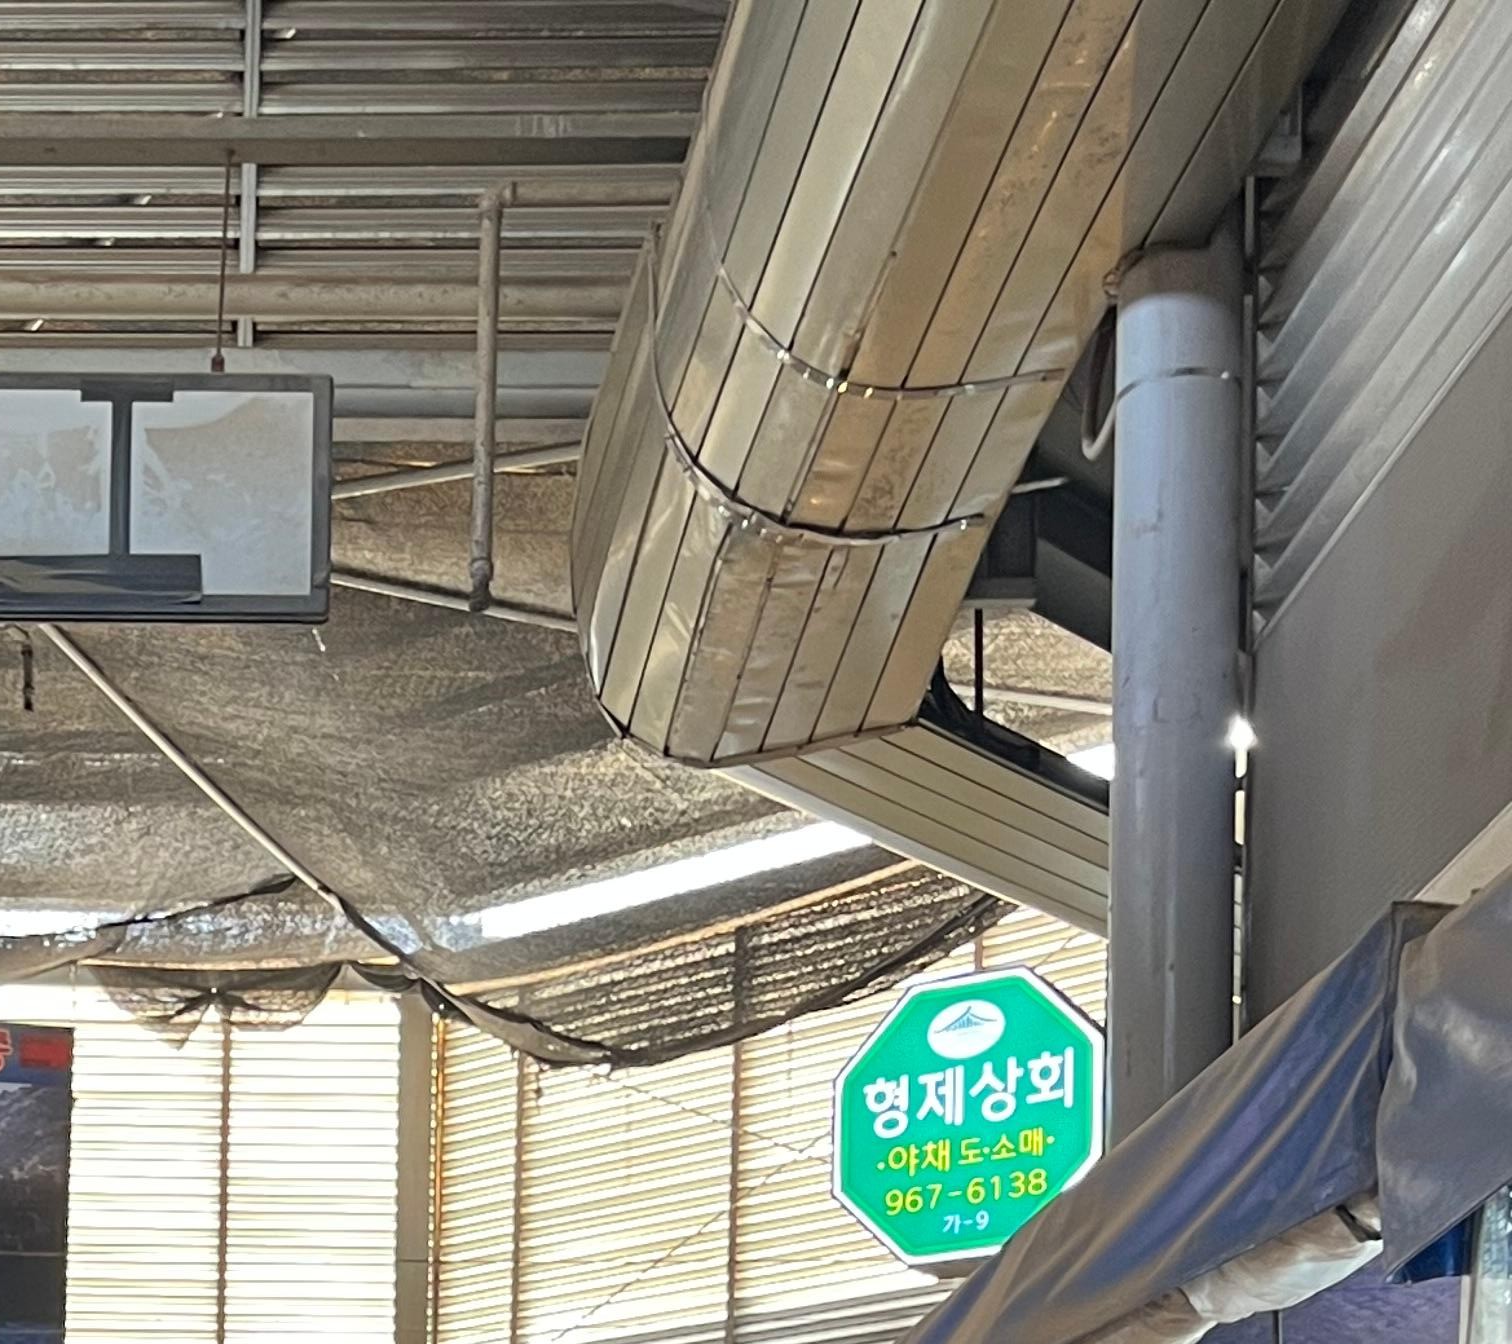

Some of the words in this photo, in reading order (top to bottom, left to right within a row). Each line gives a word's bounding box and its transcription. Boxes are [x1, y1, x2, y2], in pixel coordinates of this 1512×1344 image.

[863, 1047, 1074, 1139] 형제상회
[885, 1168, 1048, 1216] 967-6138
[942, 1209, 990, 1234] 가-9
